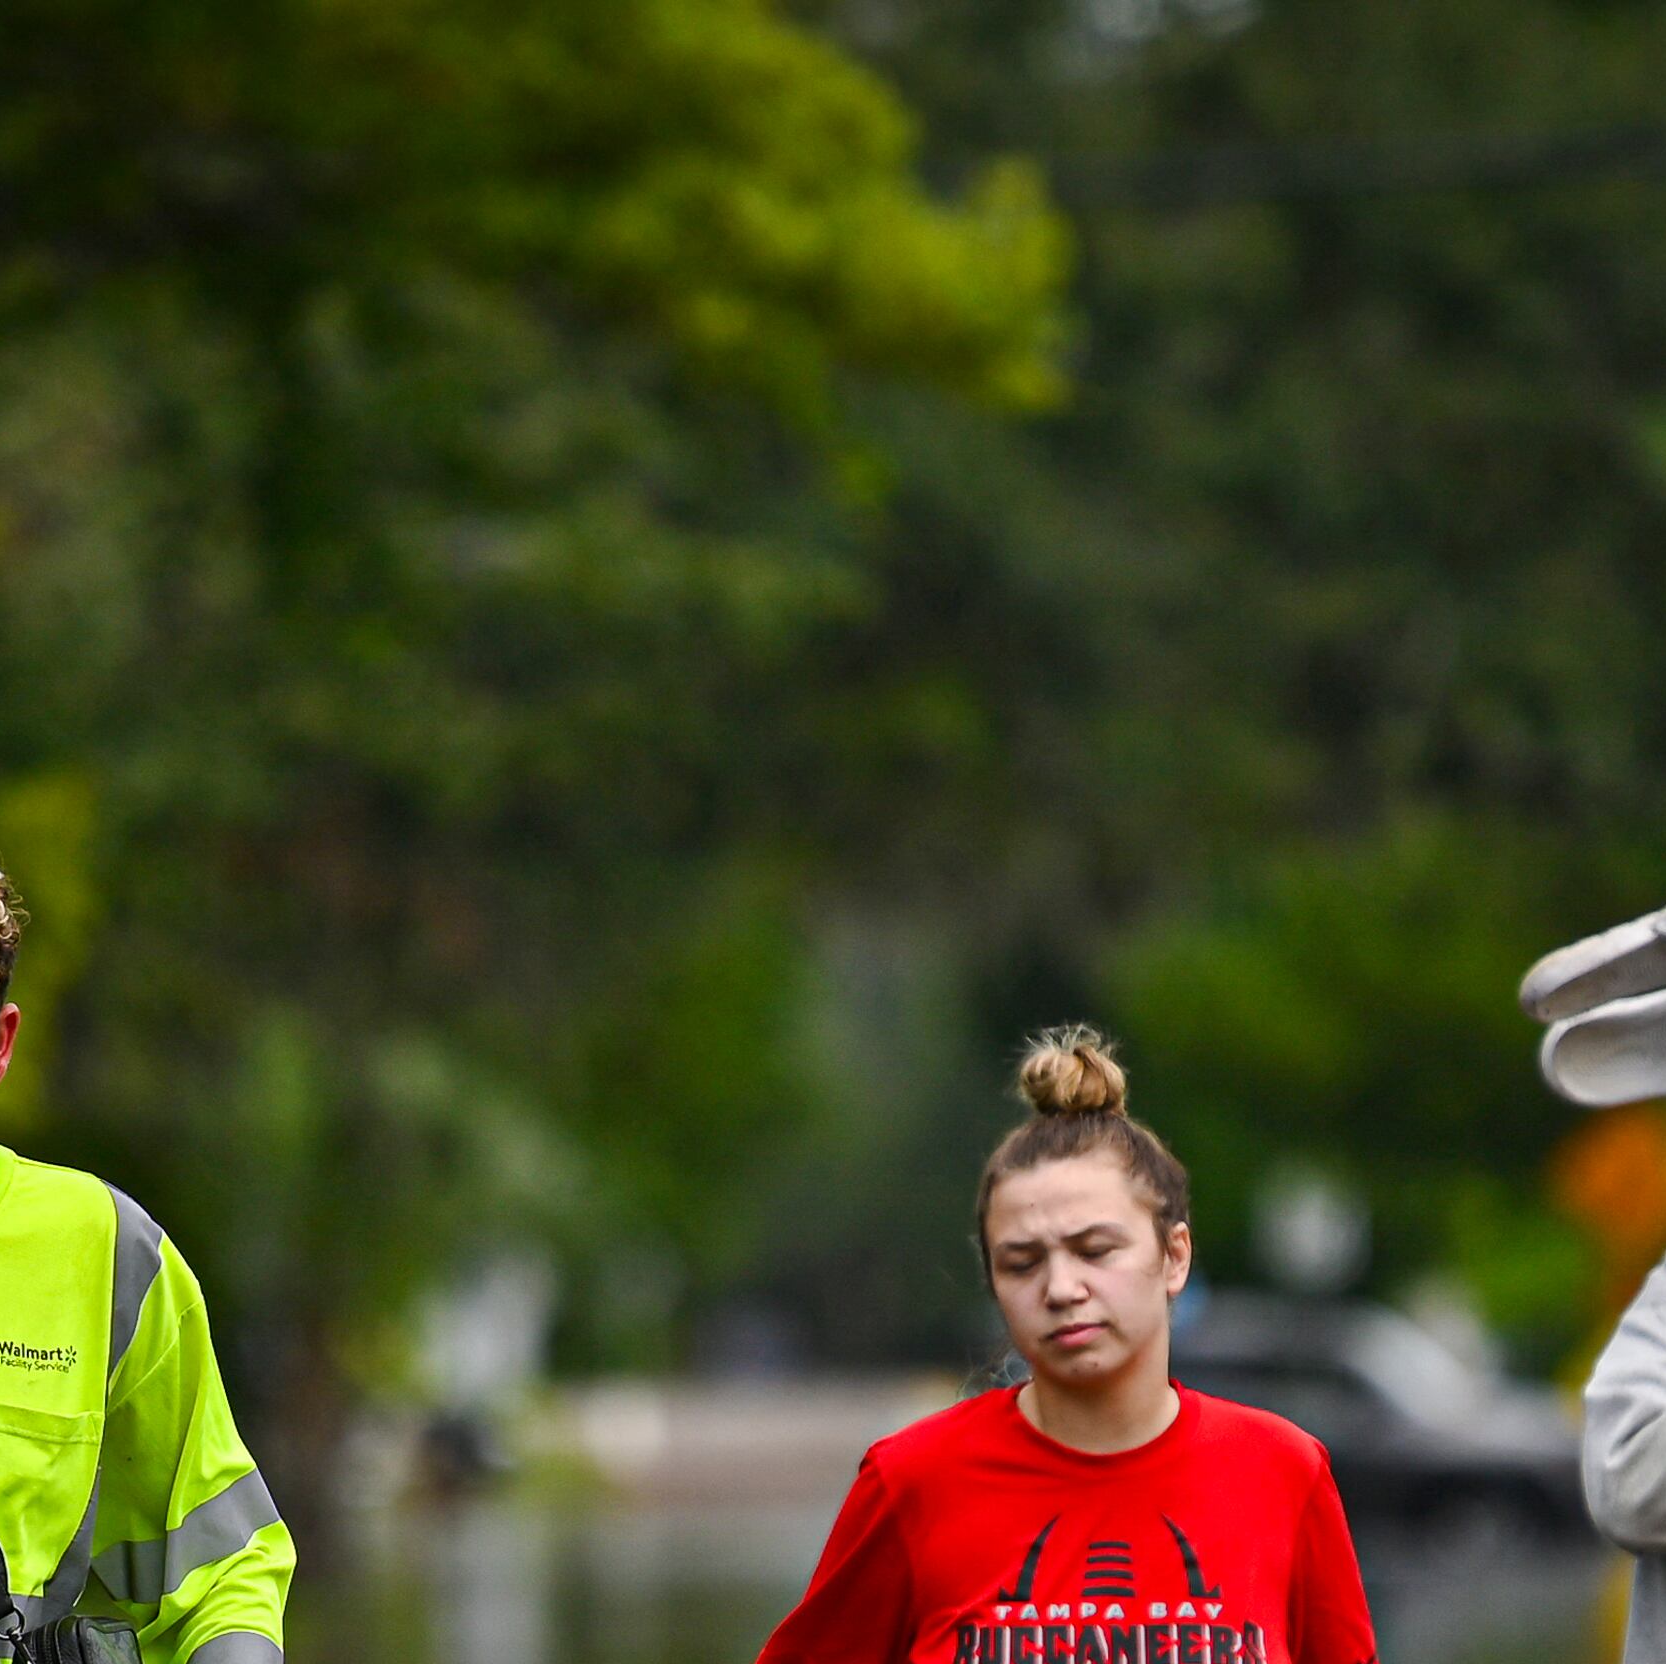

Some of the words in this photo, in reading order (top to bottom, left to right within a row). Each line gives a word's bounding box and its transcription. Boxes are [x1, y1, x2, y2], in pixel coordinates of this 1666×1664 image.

[0, 1356, 33, 1372] Facility
[995, 1601, 1126, 1620] TAMPA
[1149, 1601, 1224, 1619] BAY
